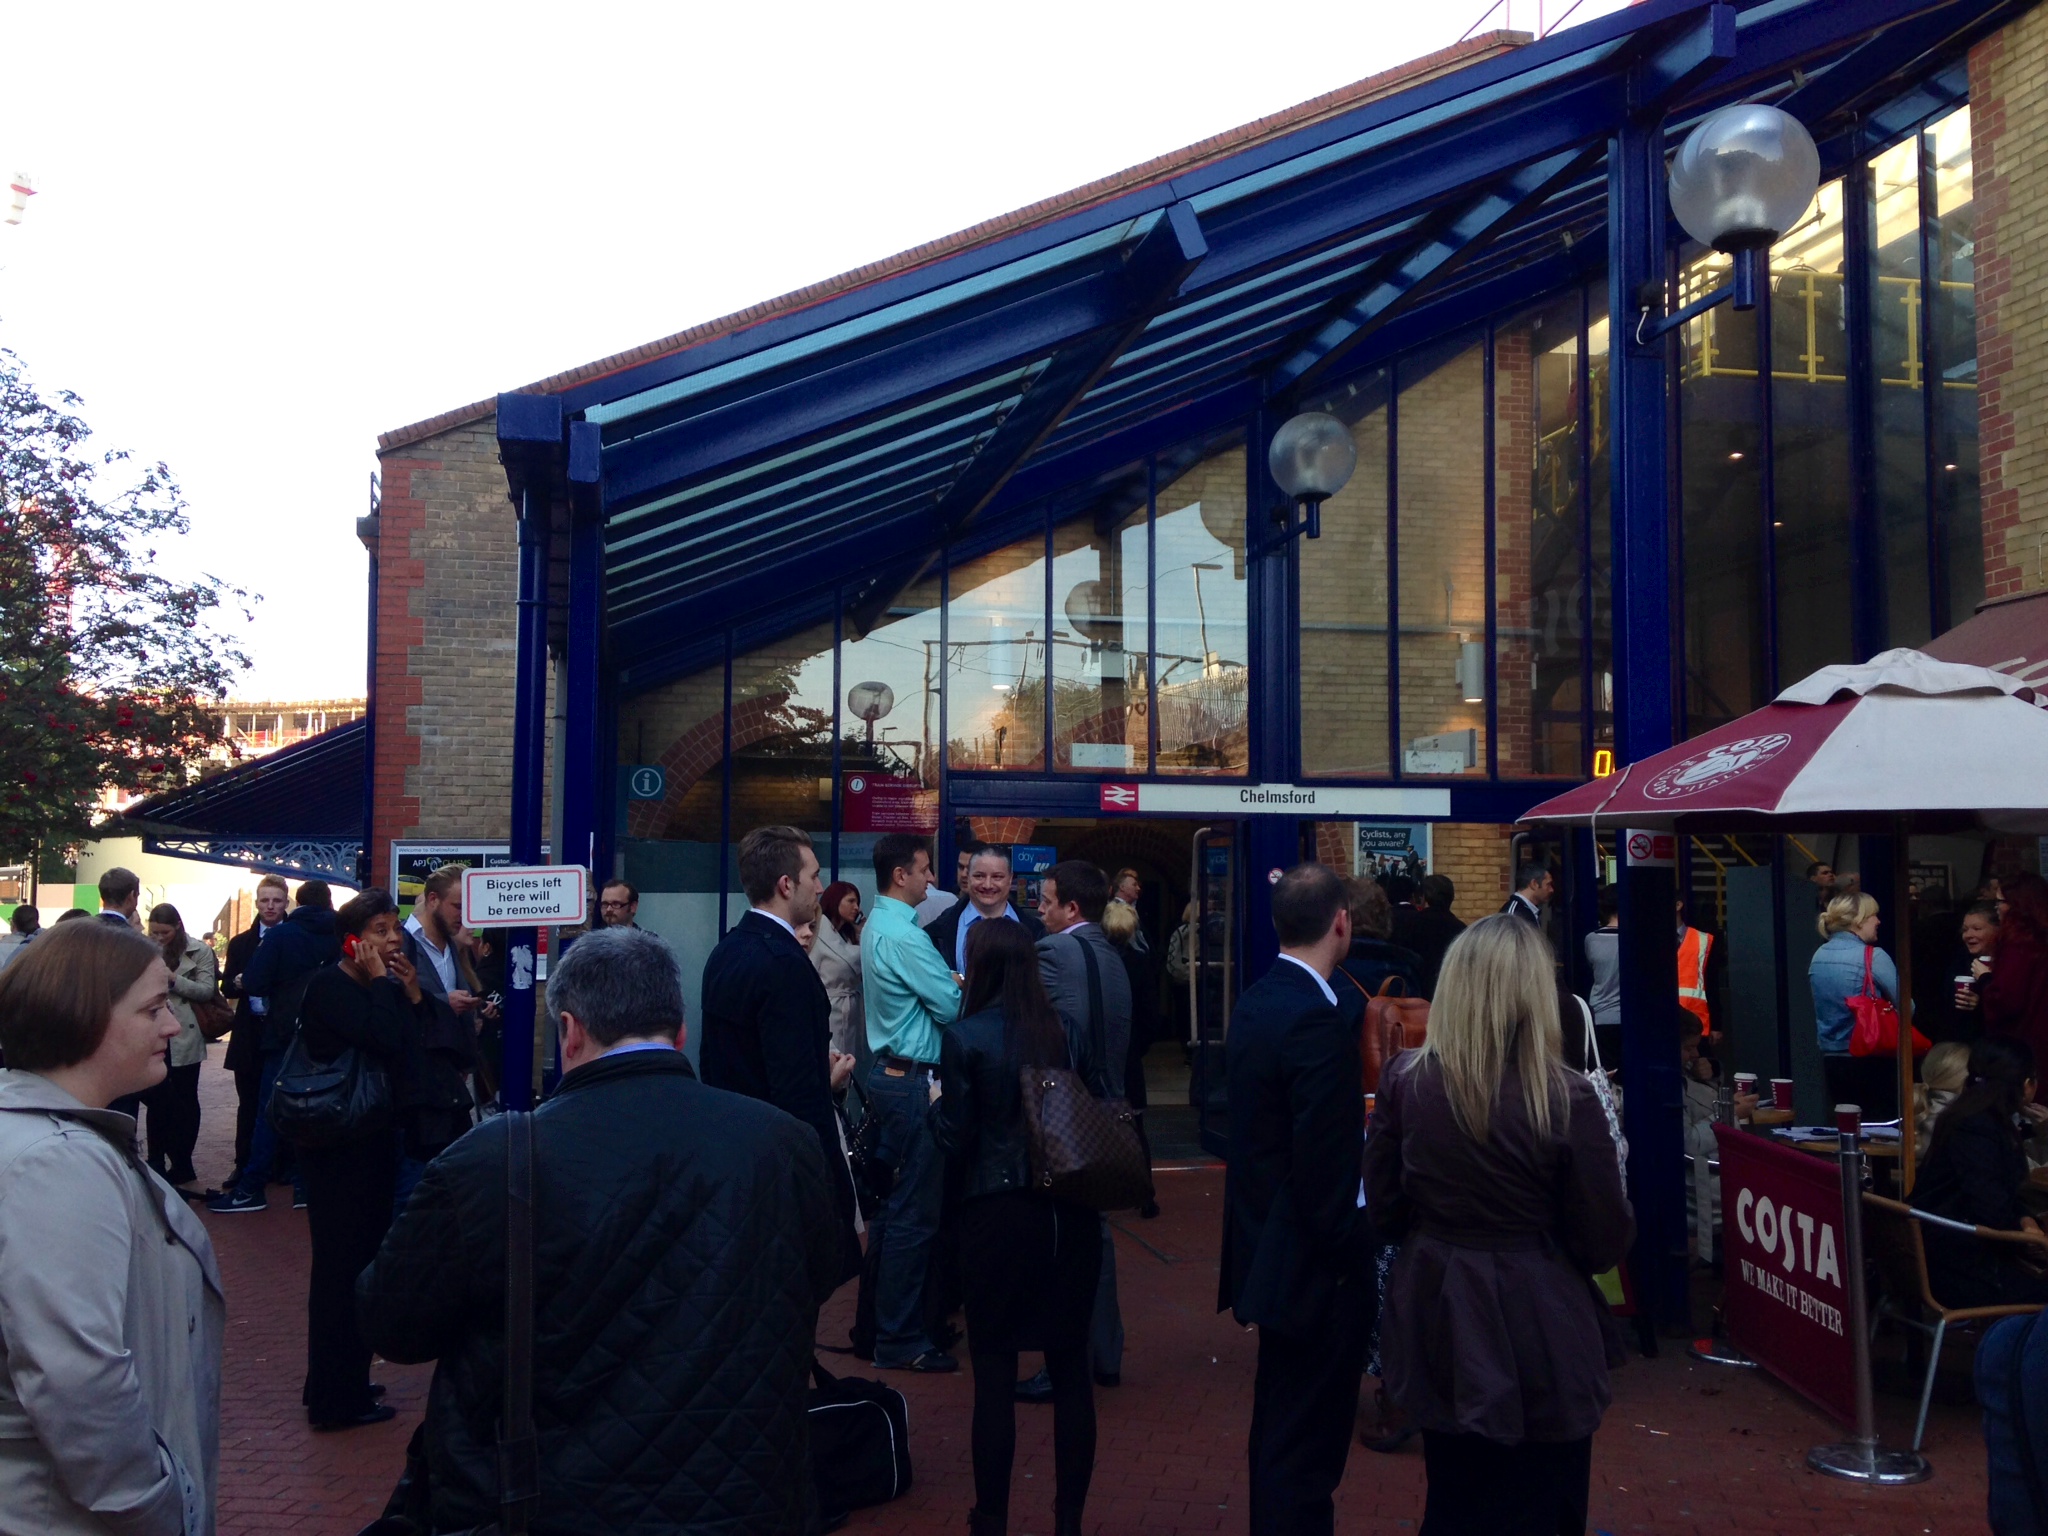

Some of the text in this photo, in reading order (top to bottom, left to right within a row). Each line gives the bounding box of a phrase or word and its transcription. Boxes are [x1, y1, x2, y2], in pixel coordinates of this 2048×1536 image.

[1707, 734, 1787, 758] COSTA
[1240, 789, 1316, 804] Chelmsford
[1361, 829, 1392, 840] Cyclists,
[412, 859, 427, 867] APJ
[486, 877, 562, 891] Bicycles left
[498, 891, 550, 902] here will
[488, 904, 560, 916] be removed
[1737, 1187, 1842, 1289] COSTA
[1740, 1258, 1844, 1337] WE MAKE IT BETTER
